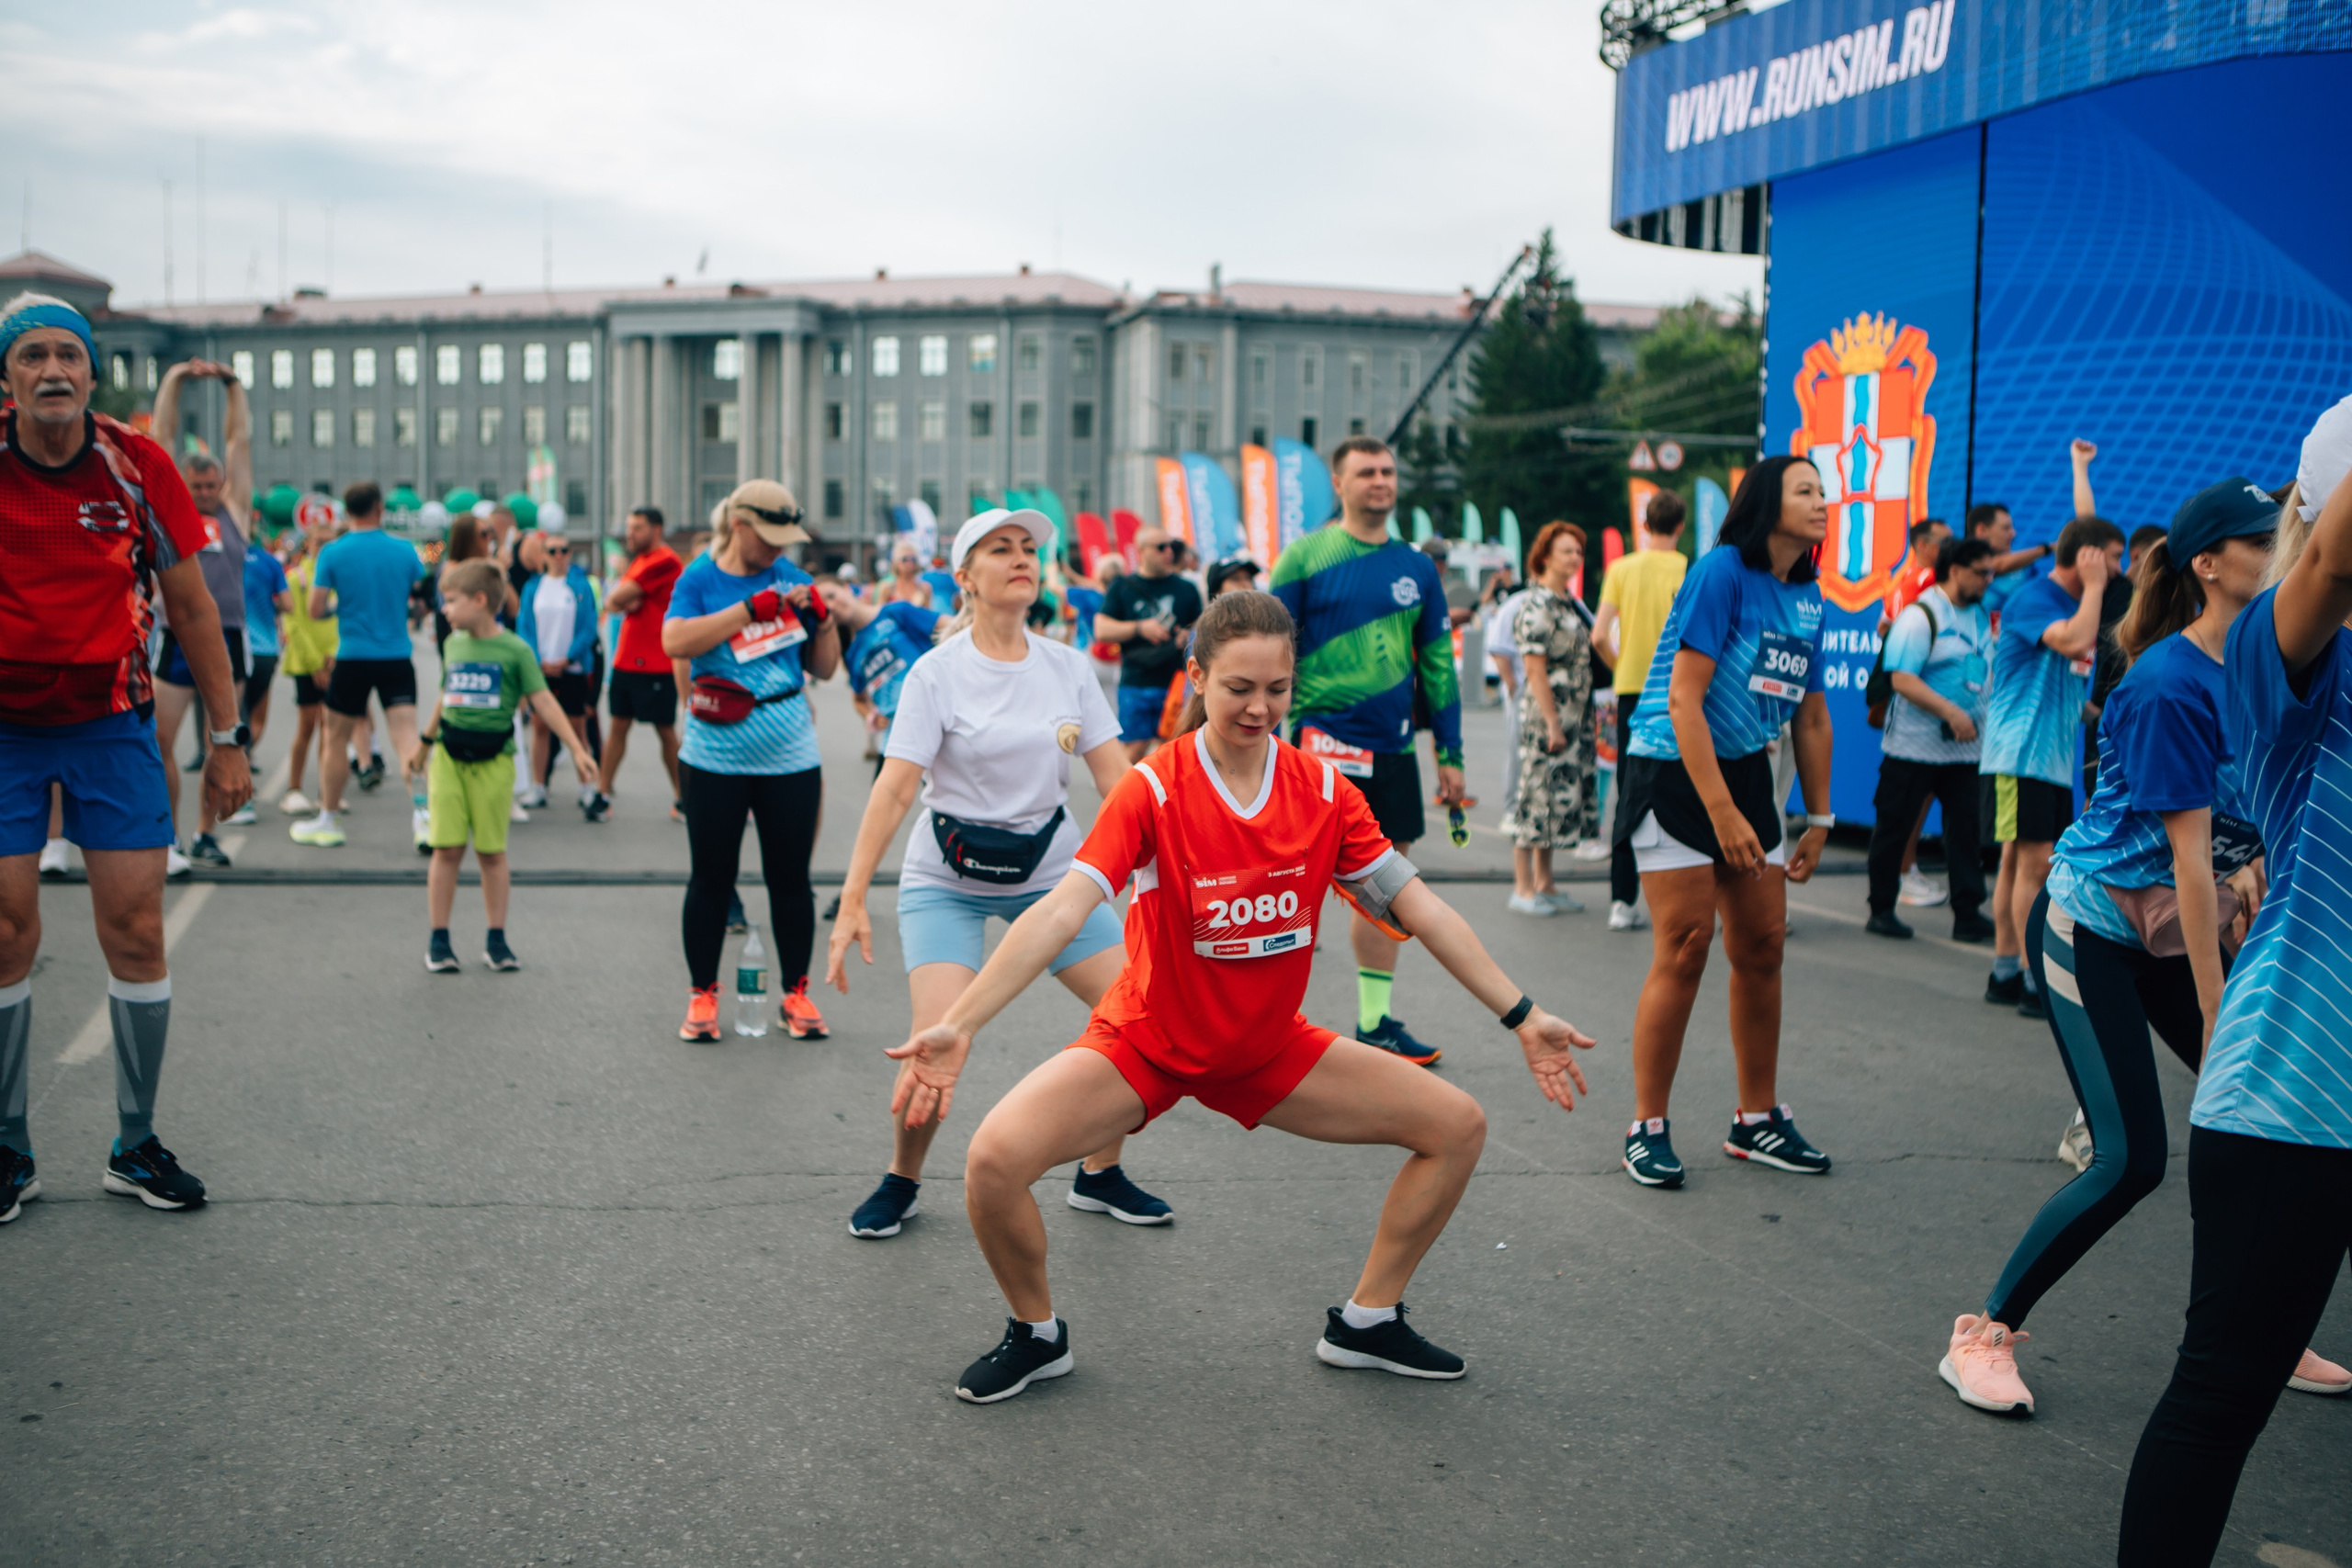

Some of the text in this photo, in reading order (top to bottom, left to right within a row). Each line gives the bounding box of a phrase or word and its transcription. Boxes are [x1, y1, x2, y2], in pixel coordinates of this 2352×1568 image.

[1665, 0, 1955, 153] WWW.RUNSIM.RU
[1822, 630, 1883, 654] ИТЕЛЬ
[1764, 648, 1808, 677] 3069
[448, 672, 492, 692] 3229
[963, 858, 1022, 874] Champion
[1206, 890, 1298, 929] 2080
